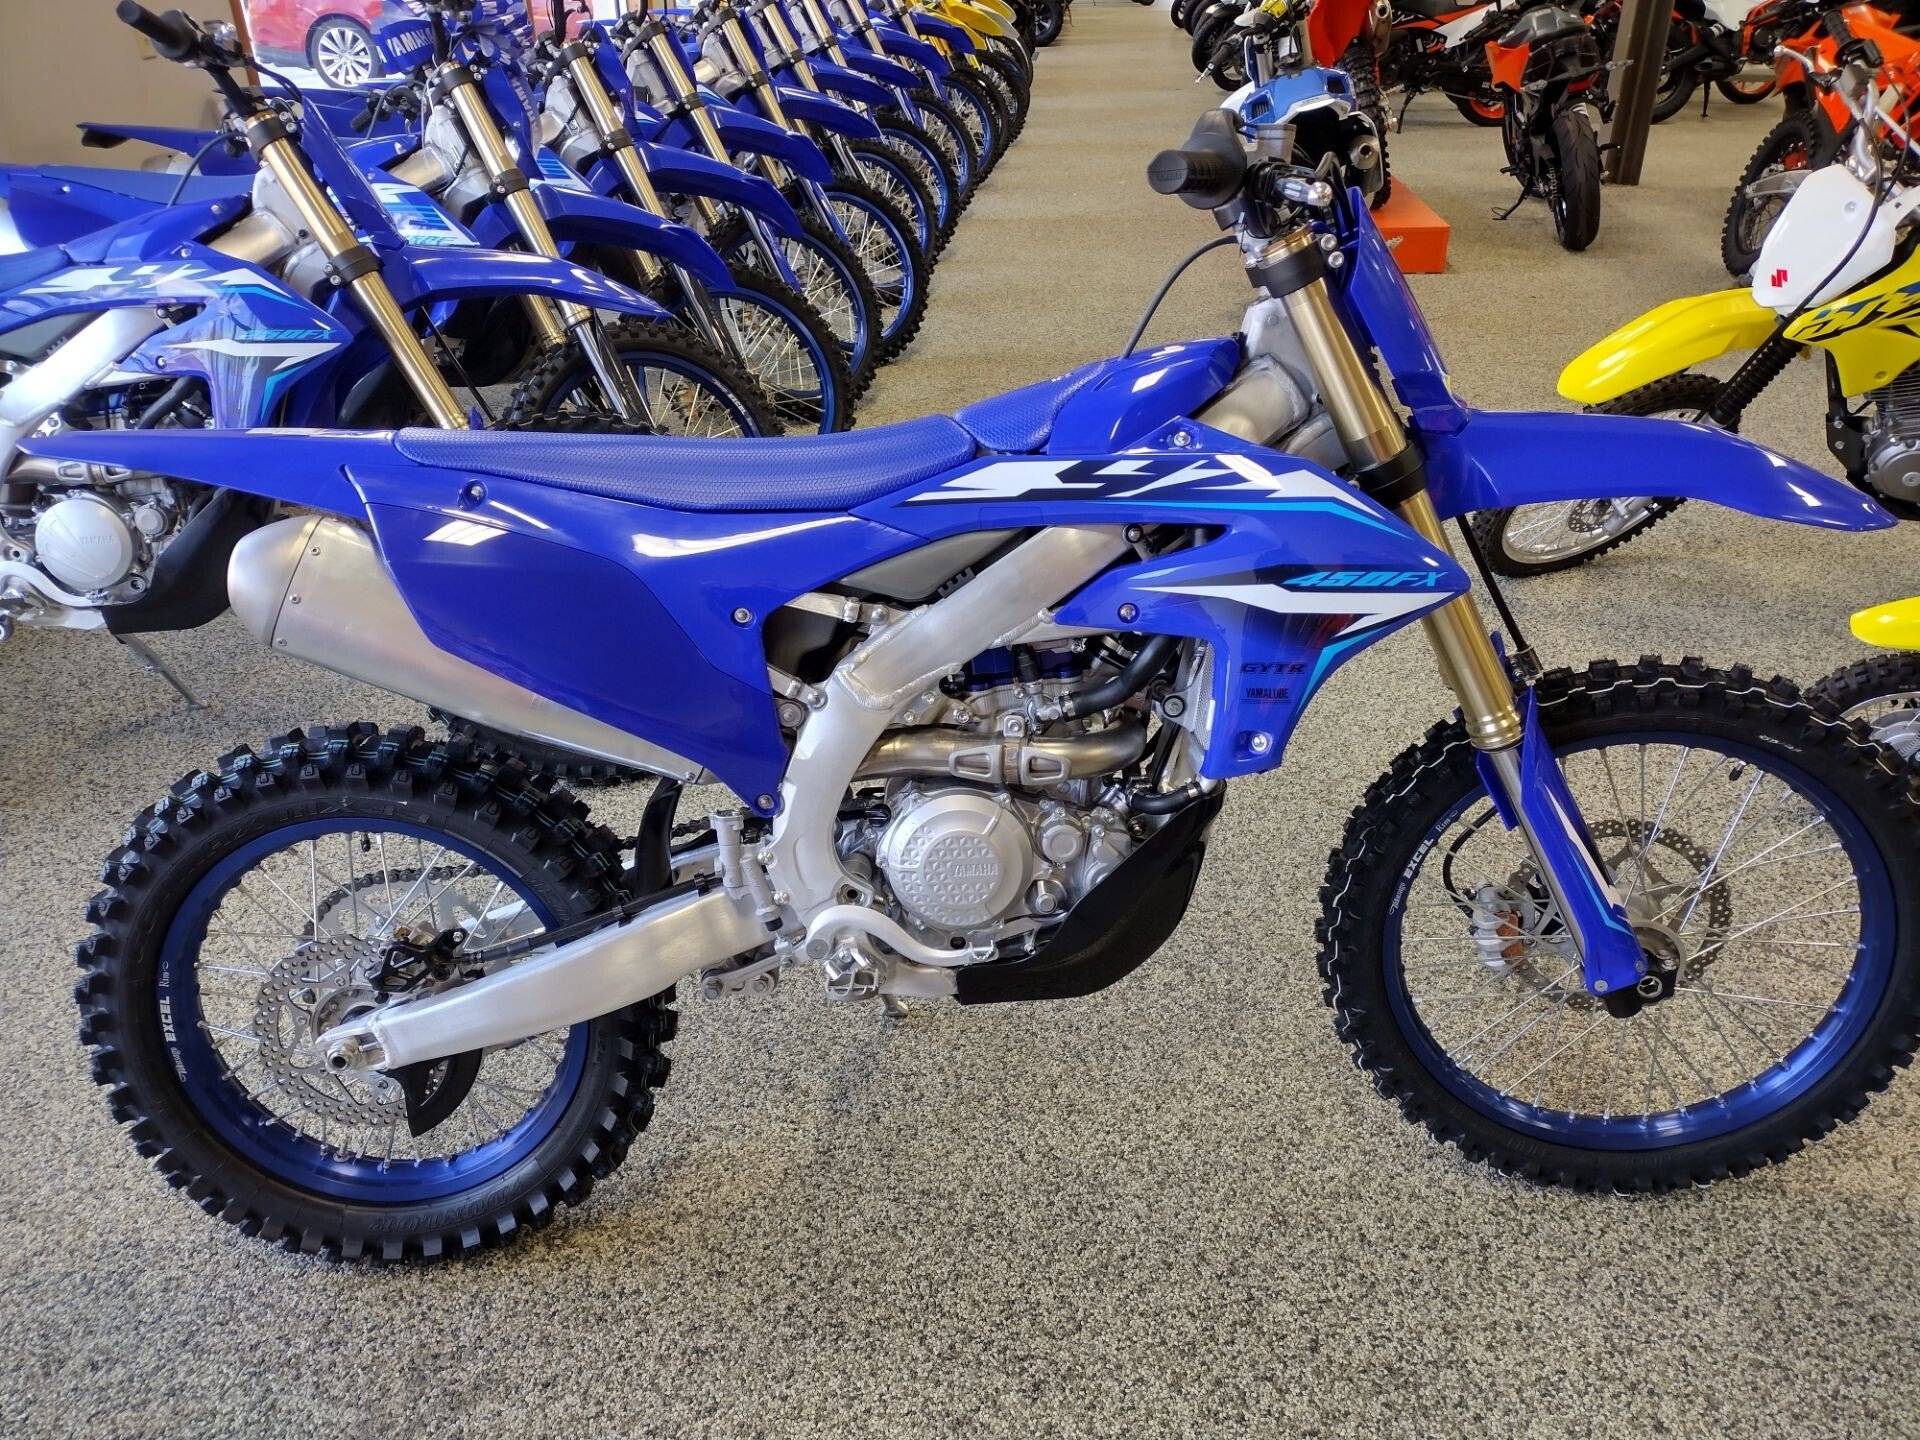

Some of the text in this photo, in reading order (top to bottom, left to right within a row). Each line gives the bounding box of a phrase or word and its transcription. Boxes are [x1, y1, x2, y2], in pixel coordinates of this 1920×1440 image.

[1281, 571, 1449, 588] 450FX
[1241, 662, 1306, 673] GYTR
[1246, 687, 1289, 699] YAMALUBE
[1402, 838, 1434, 879] EXCEL
[952, 862, 999, 878] YAMAHA
[160, 995, 177, 1042] EXCEL
